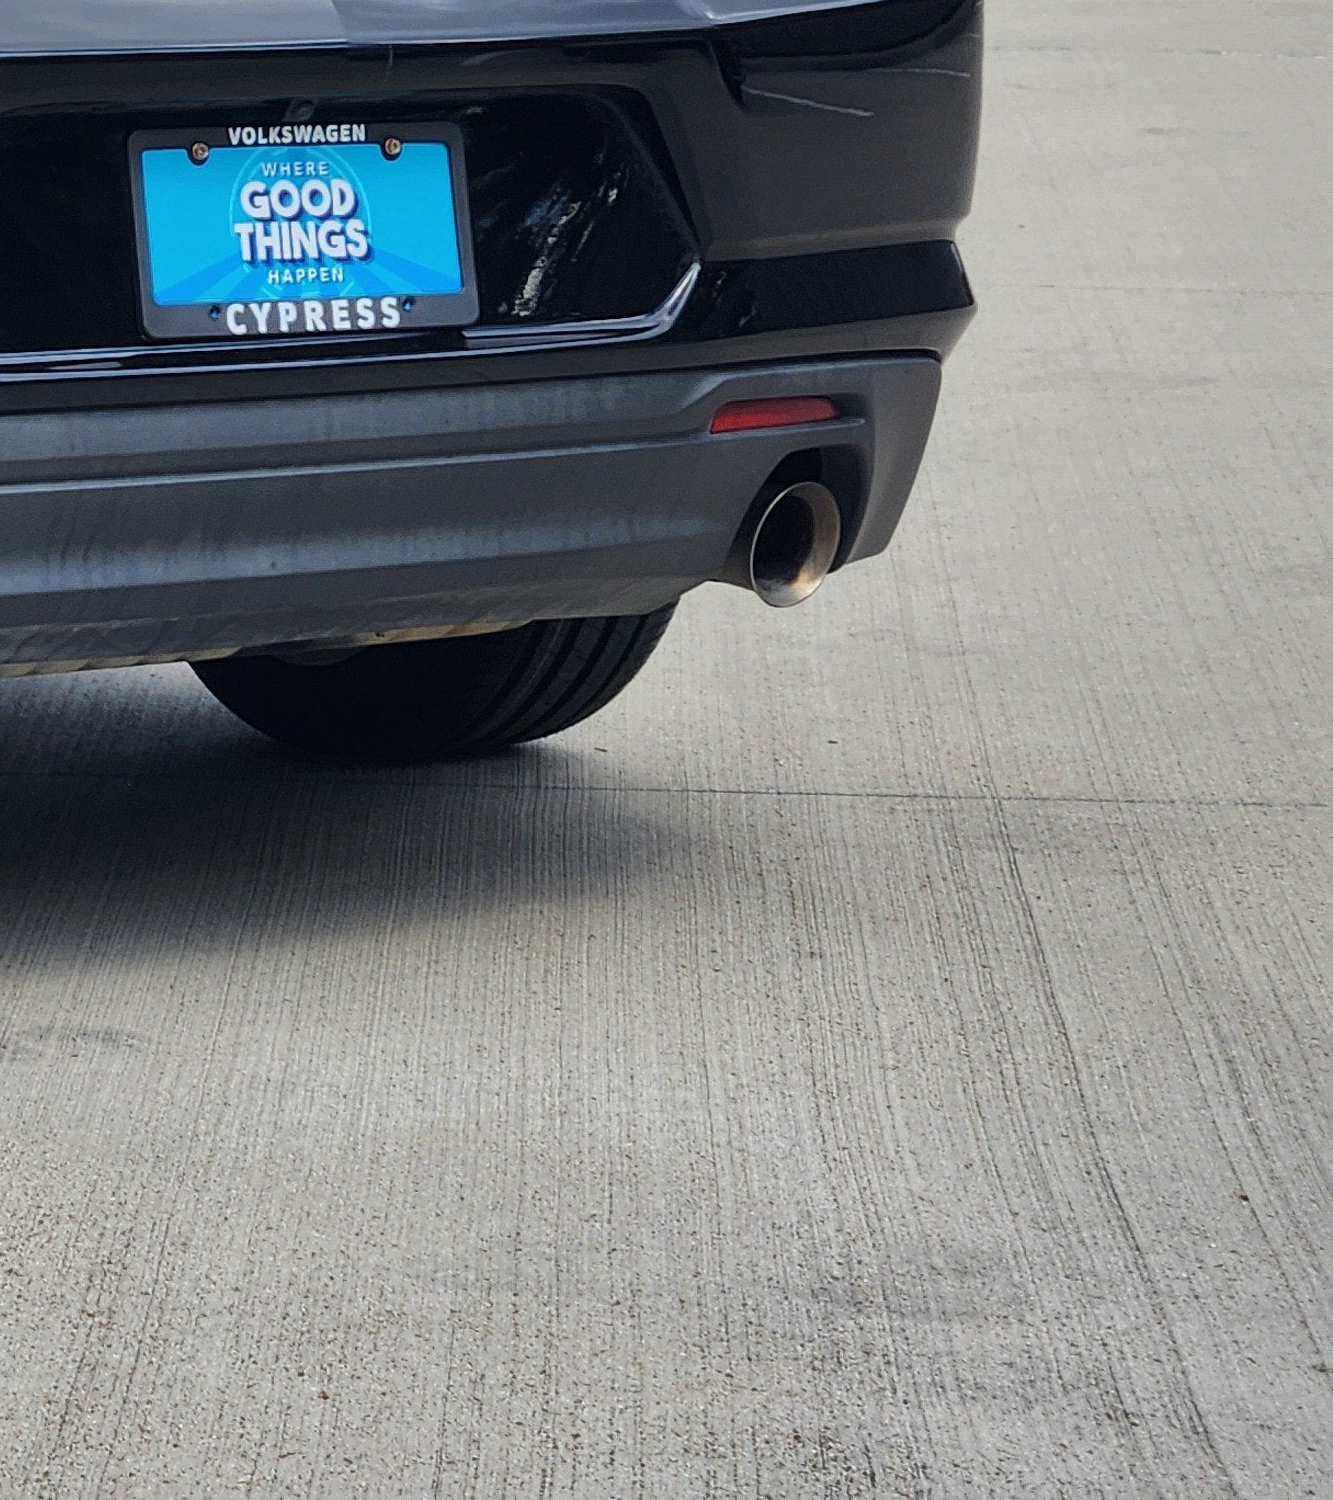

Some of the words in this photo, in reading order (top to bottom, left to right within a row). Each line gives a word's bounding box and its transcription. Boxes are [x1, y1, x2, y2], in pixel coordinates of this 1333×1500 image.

[228, 124, 366, 146] VOLKSWAGEN
[261, 161, 330, 177] WHERE
[240, 178, 355, 220] GOOD
[234, 218, 369, 262] THINGS
[267, 267, 344, 285] HAPPEN
[226, 296, 401, 336] CYPRESS
